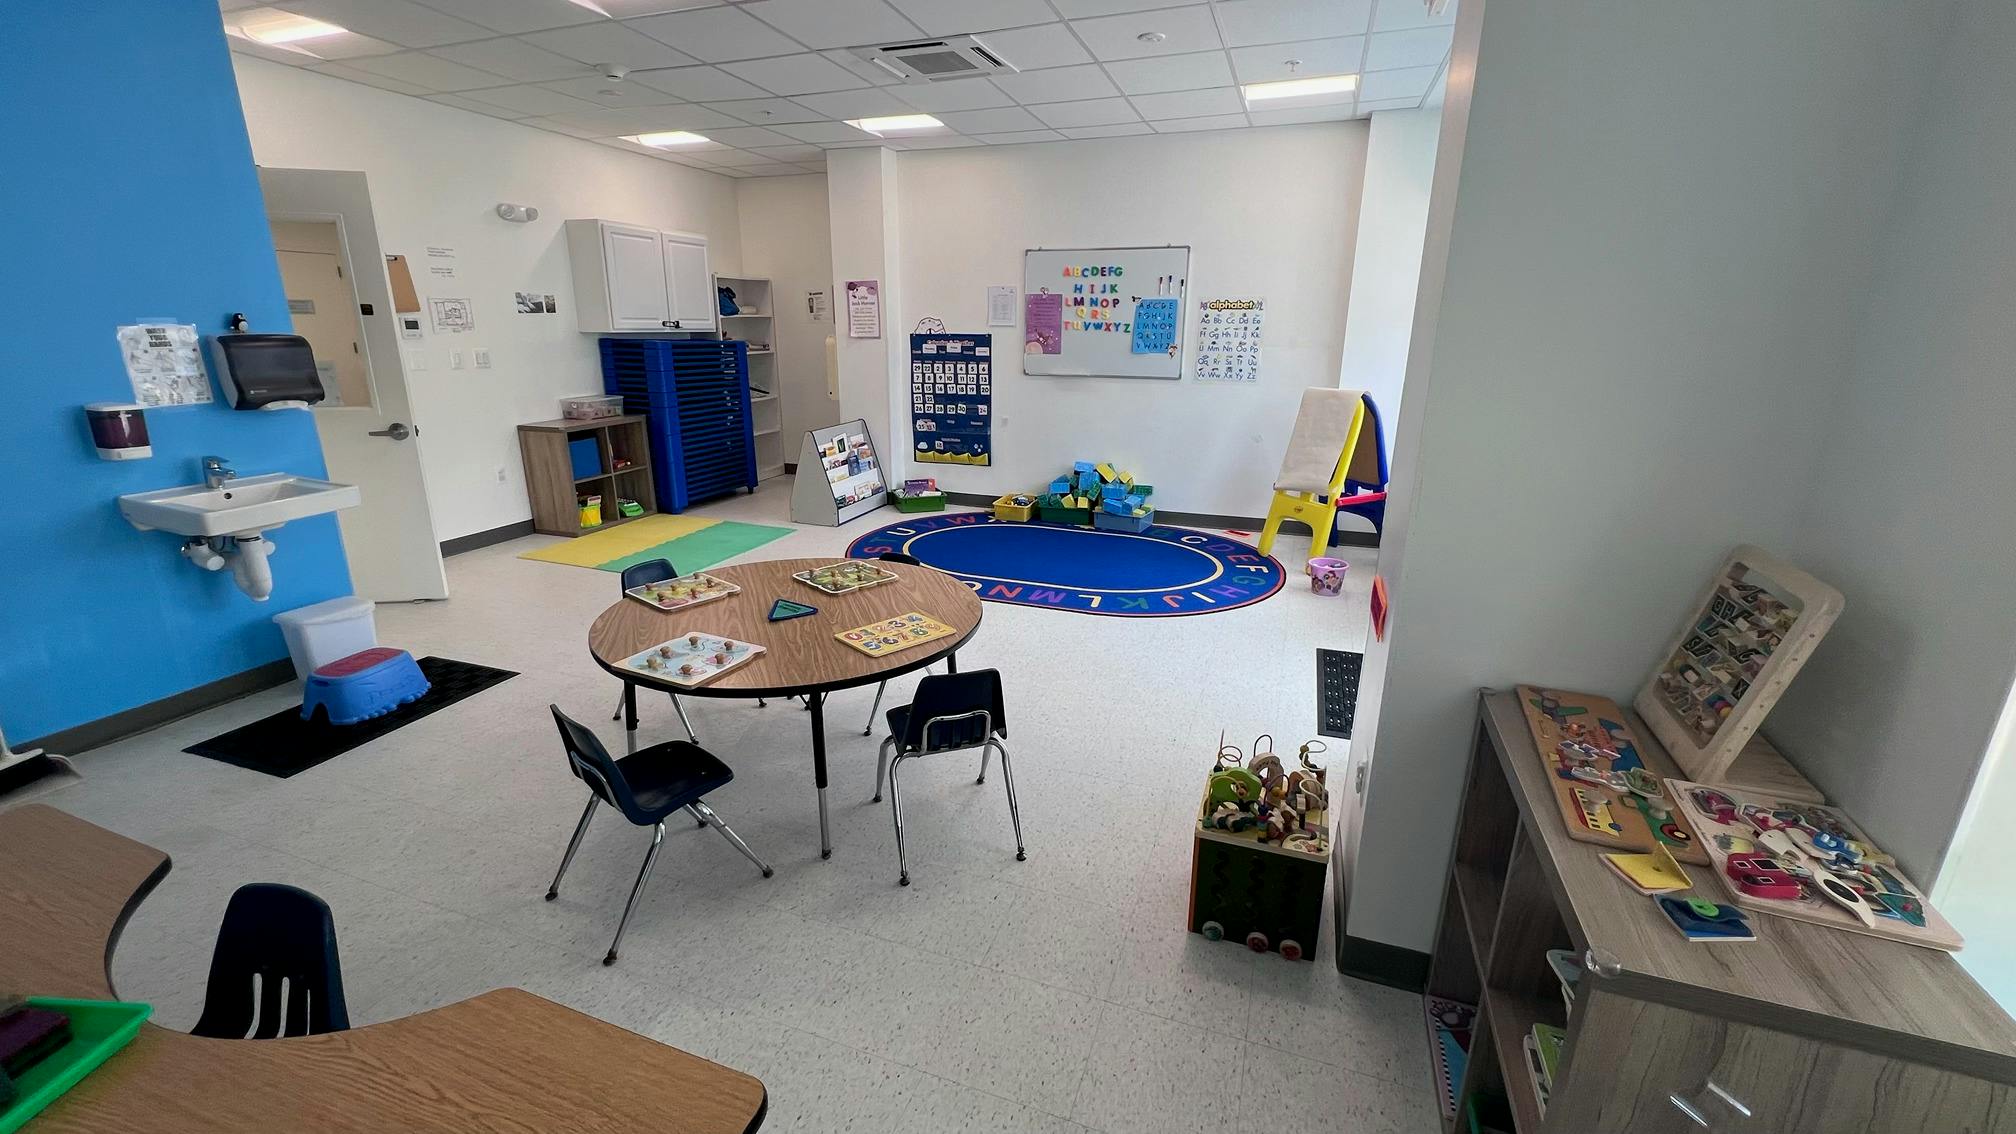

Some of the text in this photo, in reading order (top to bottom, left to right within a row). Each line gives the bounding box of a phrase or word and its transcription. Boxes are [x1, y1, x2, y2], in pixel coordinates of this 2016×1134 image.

[1209, 299, 1255, 312] alphabet
[1235, 565, 1269, 573] F
[1208, 584, 1250, 599] H
[1078, 594, 1102, 608] L
